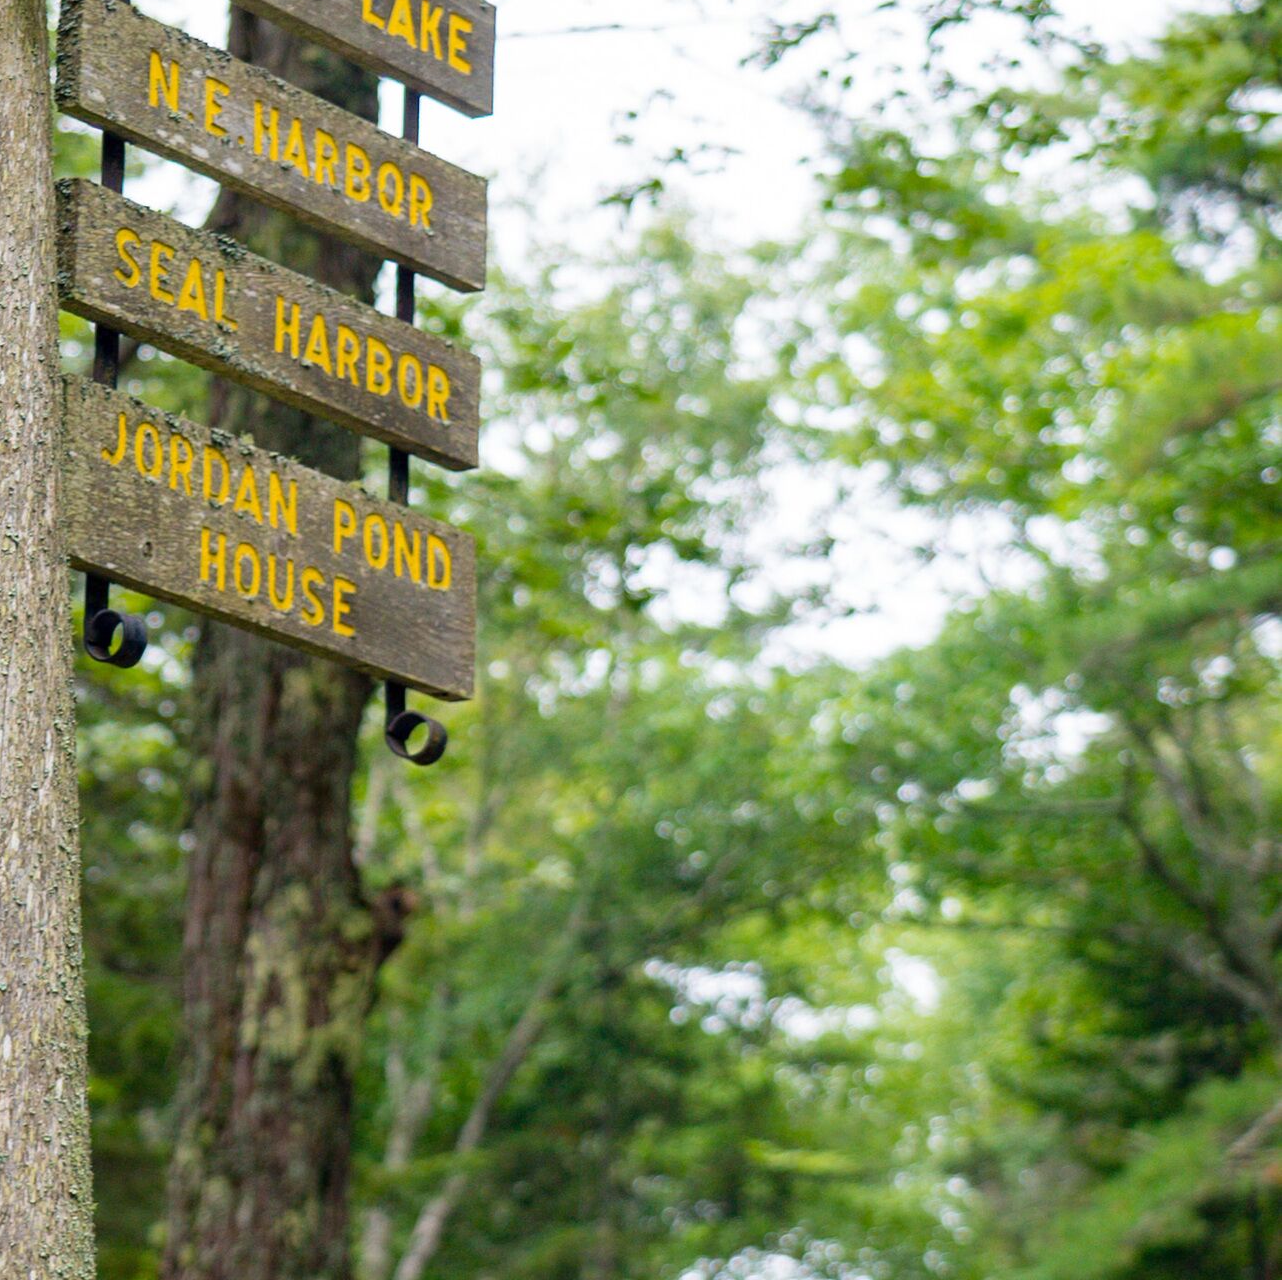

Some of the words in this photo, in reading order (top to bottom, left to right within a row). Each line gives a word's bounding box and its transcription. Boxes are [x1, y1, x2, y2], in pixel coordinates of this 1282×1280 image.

[253, 100, 434, 227] HARBOR
[113, 226, 239, 330] SEAL
[273, 295, 452, 420] HARBOR
[100, 412, 299, 535] JORDAN
[332, 498, 453, 592] POND
[199, 525, 358, 637] HOUSE
